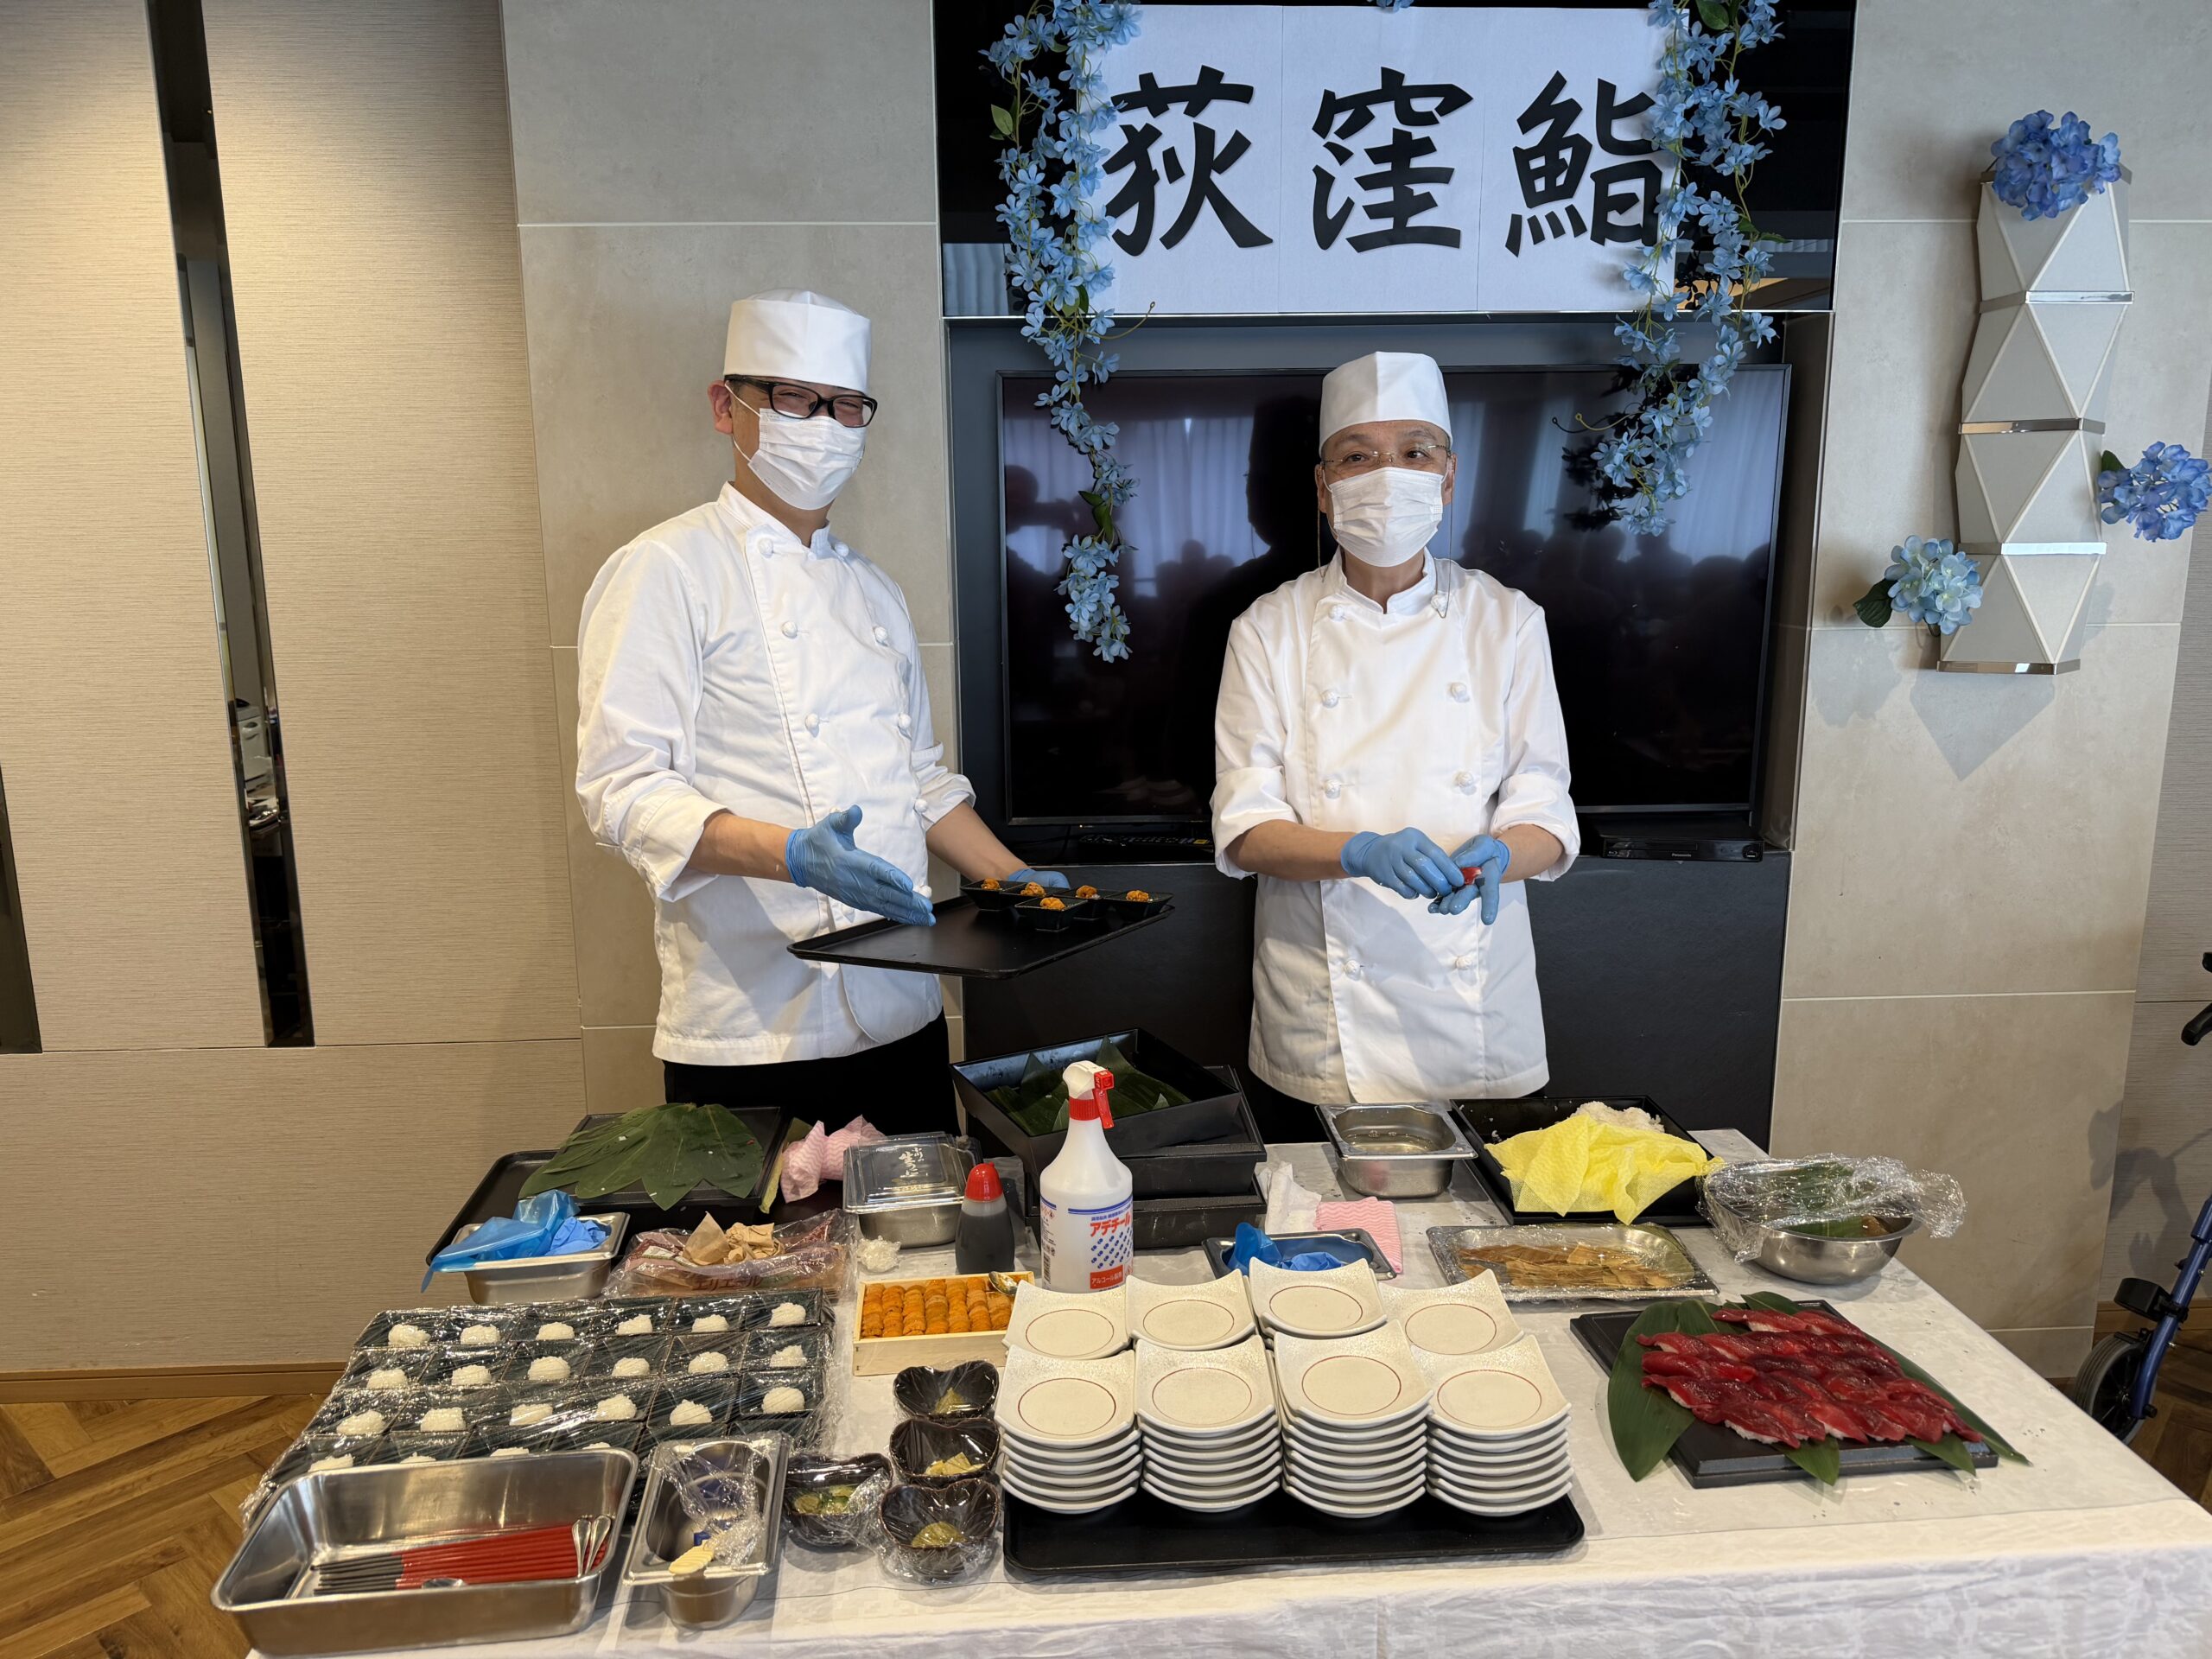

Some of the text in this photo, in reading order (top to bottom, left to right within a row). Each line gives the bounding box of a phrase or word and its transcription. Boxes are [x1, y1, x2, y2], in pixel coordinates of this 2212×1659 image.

[1103, 64, 1662, 257] 荻窪鮨
[1090, 1211, 1131, 1237] アデチール
